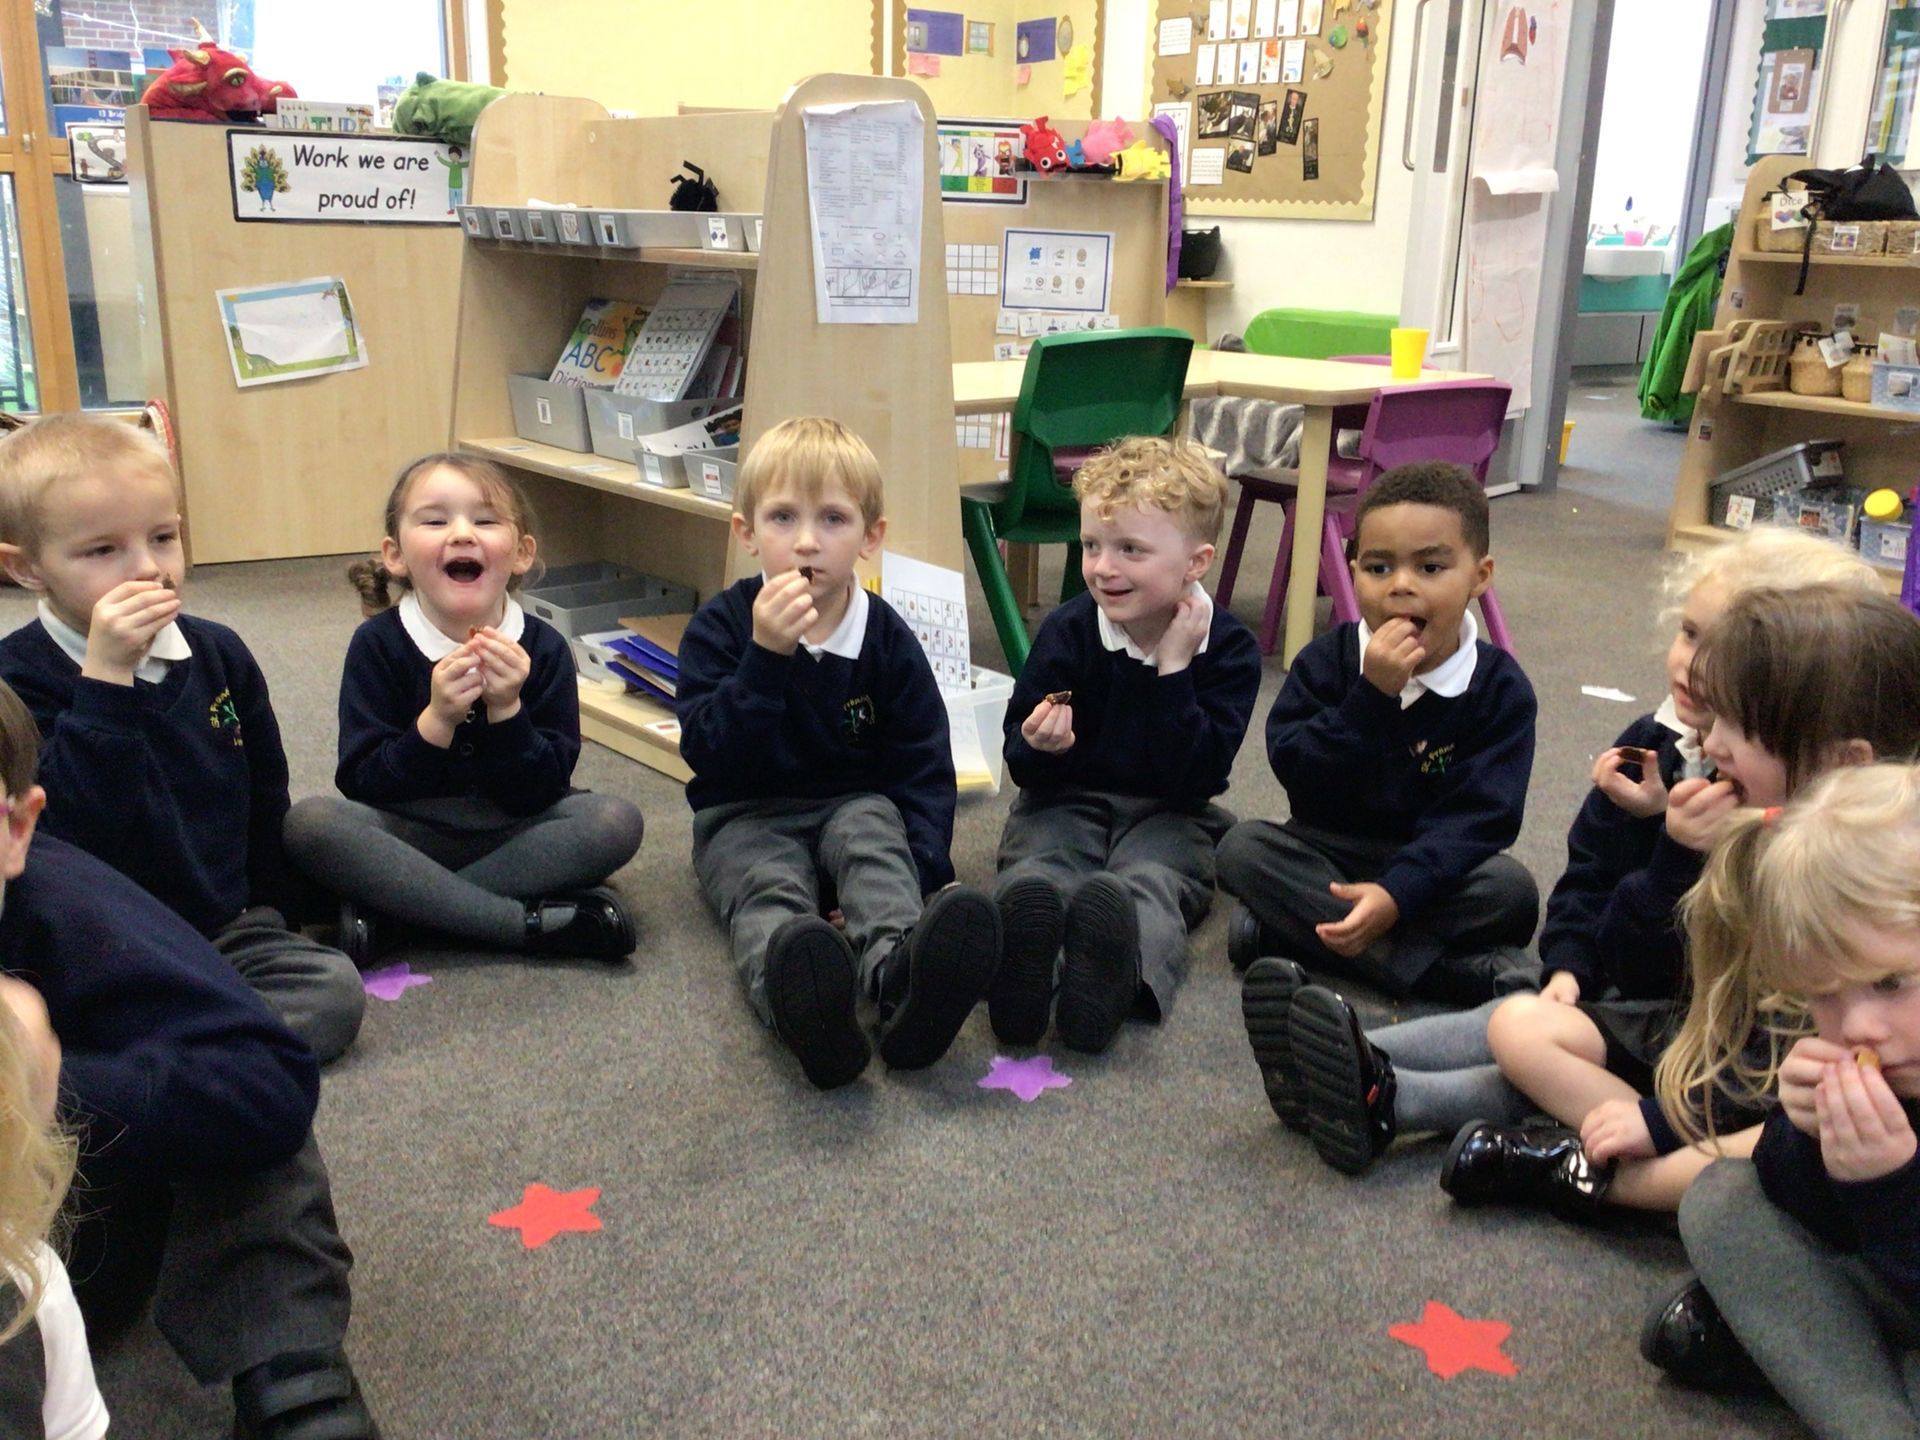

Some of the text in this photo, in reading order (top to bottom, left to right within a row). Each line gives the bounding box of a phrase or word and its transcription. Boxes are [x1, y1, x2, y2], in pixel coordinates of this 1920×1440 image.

[294, 144, 429, 171] Work we are
[318, 187, 416, 212] proud of!
[1780, 196, 1802, 207] Dice
[579, 318, 618, 339] Collins
[562, 342, 613, 373] ABC
